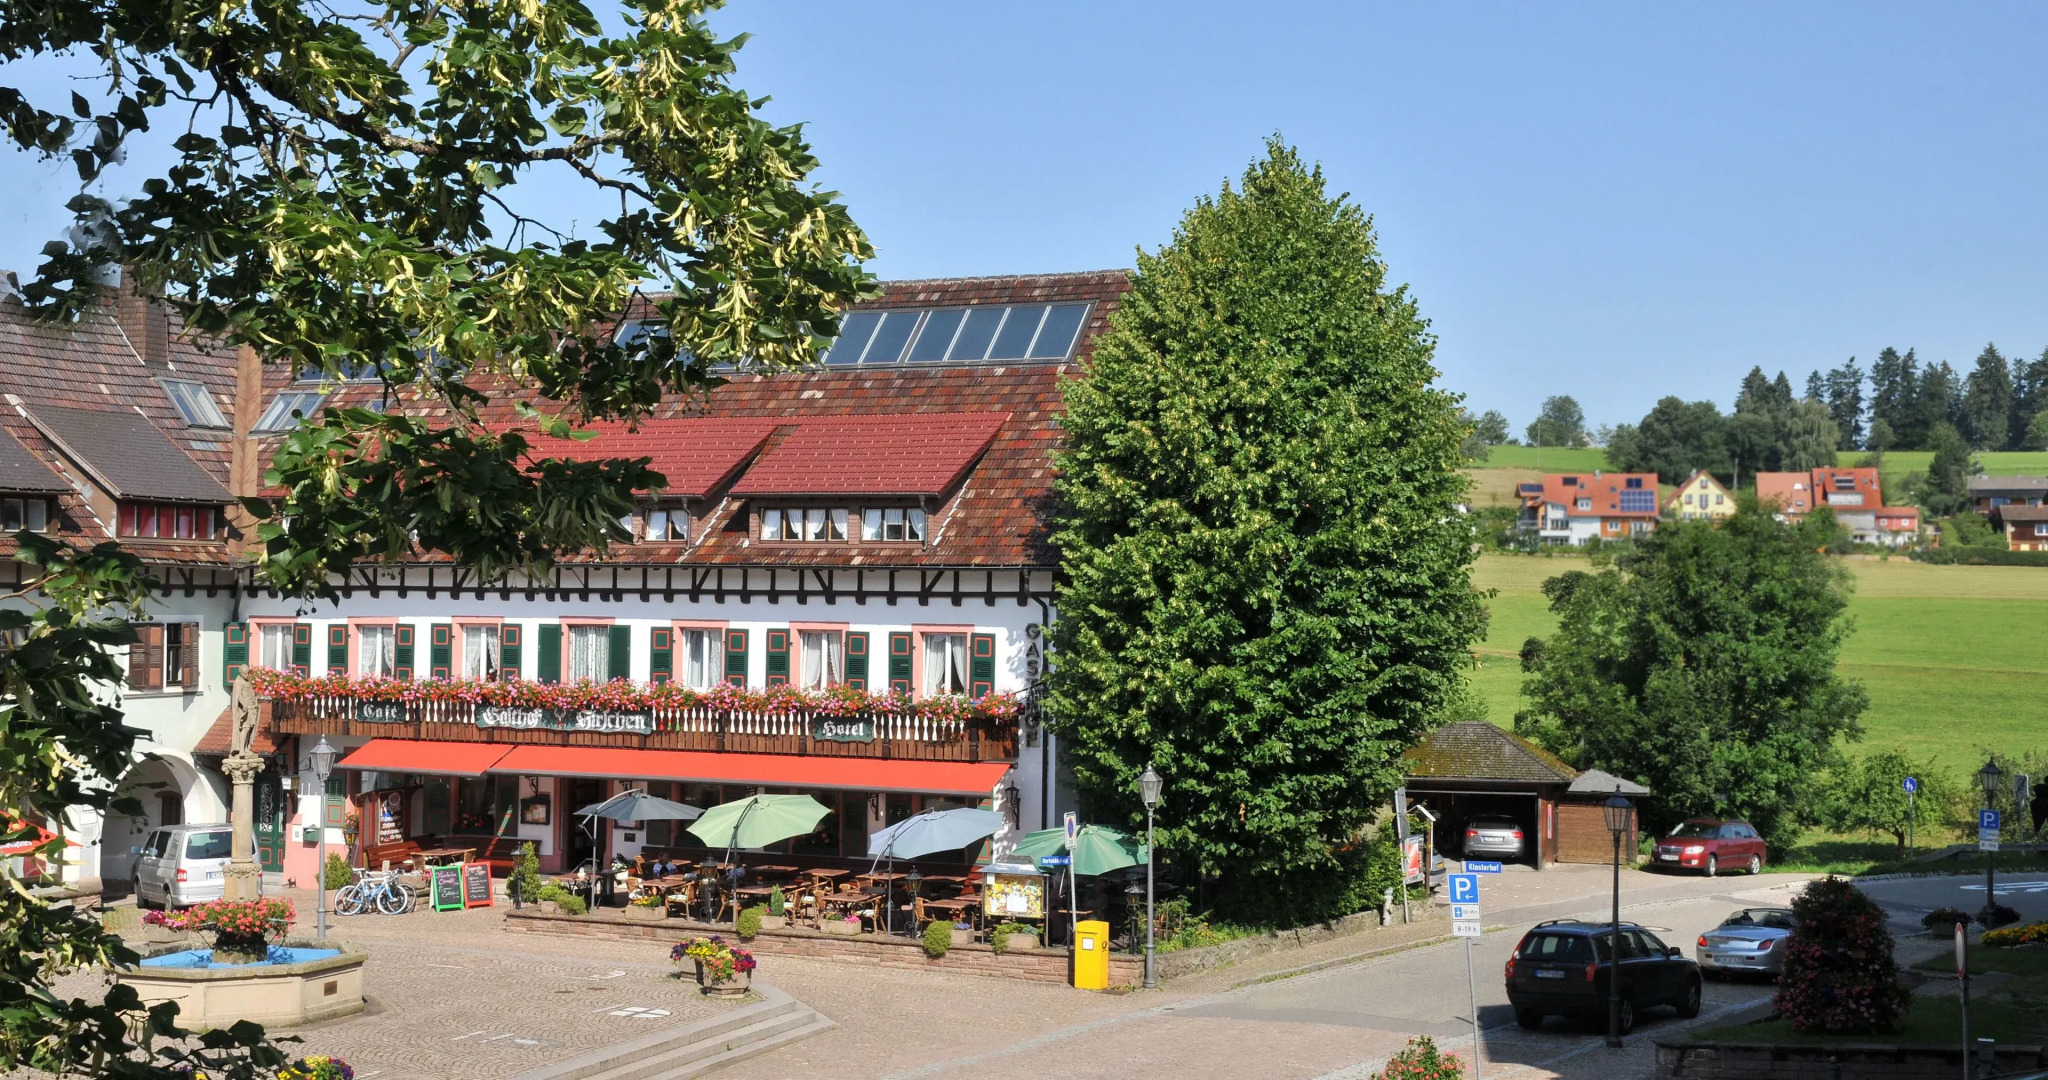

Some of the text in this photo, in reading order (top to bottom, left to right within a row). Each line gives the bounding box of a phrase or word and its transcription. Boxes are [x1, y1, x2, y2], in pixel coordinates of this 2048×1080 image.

[363, 703, 398, 721] Café
[823, 720, 864, 739] Hotel
[1984, 812, 1994, 826] P
[1468, 863, 1499, 871] Klosterhof
[1455, 877, 1471, 900] P
